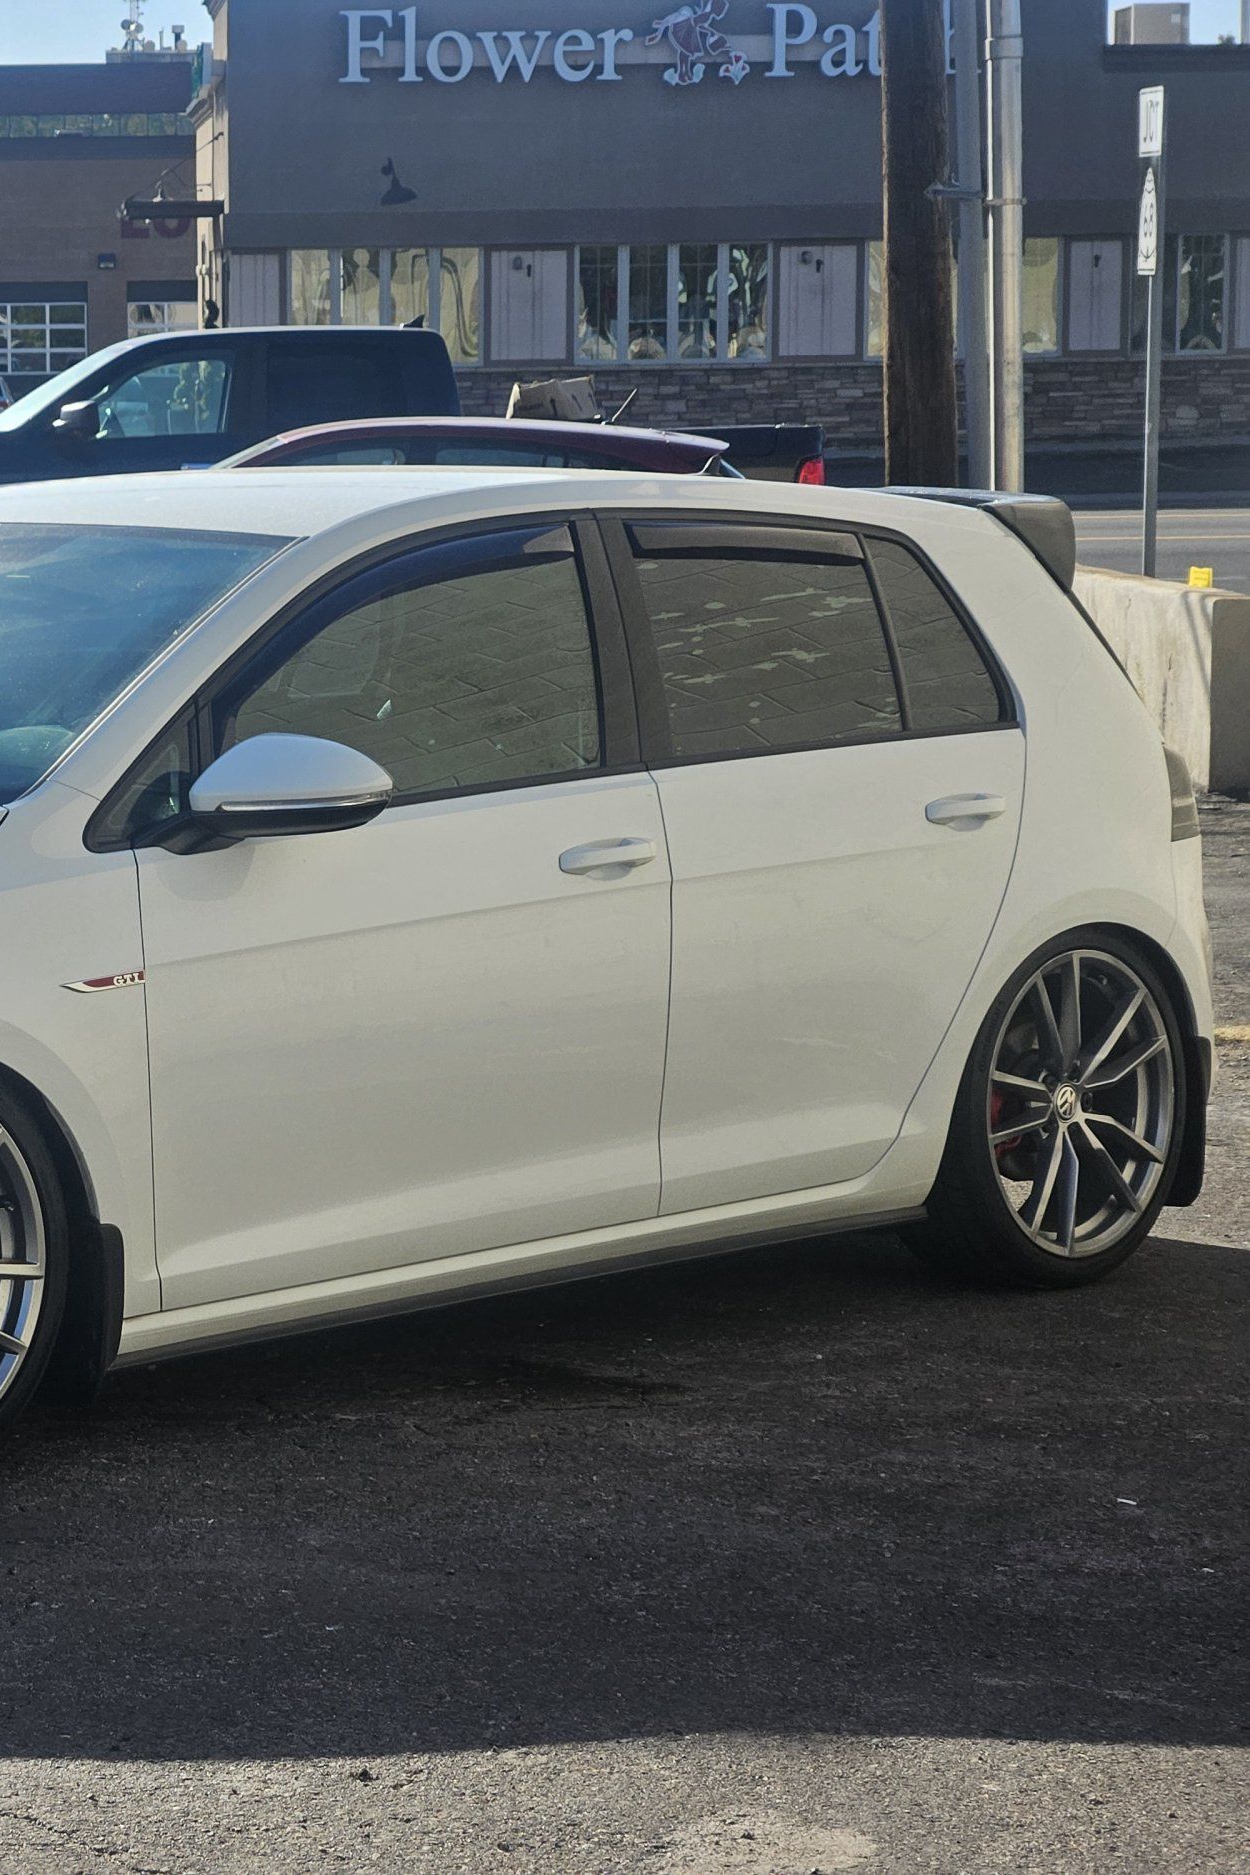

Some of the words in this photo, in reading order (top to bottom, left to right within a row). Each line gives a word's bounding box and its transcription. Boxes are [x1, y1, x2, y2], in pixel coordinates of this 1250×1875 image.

[338, 6, 634, 83] Flower
[764, 0, 982, 77] Pat
[1142, 99, 1160, 143] JCT
[1143, 202, 1154, 238] 68
[113, 972, 140, 986] GTI
